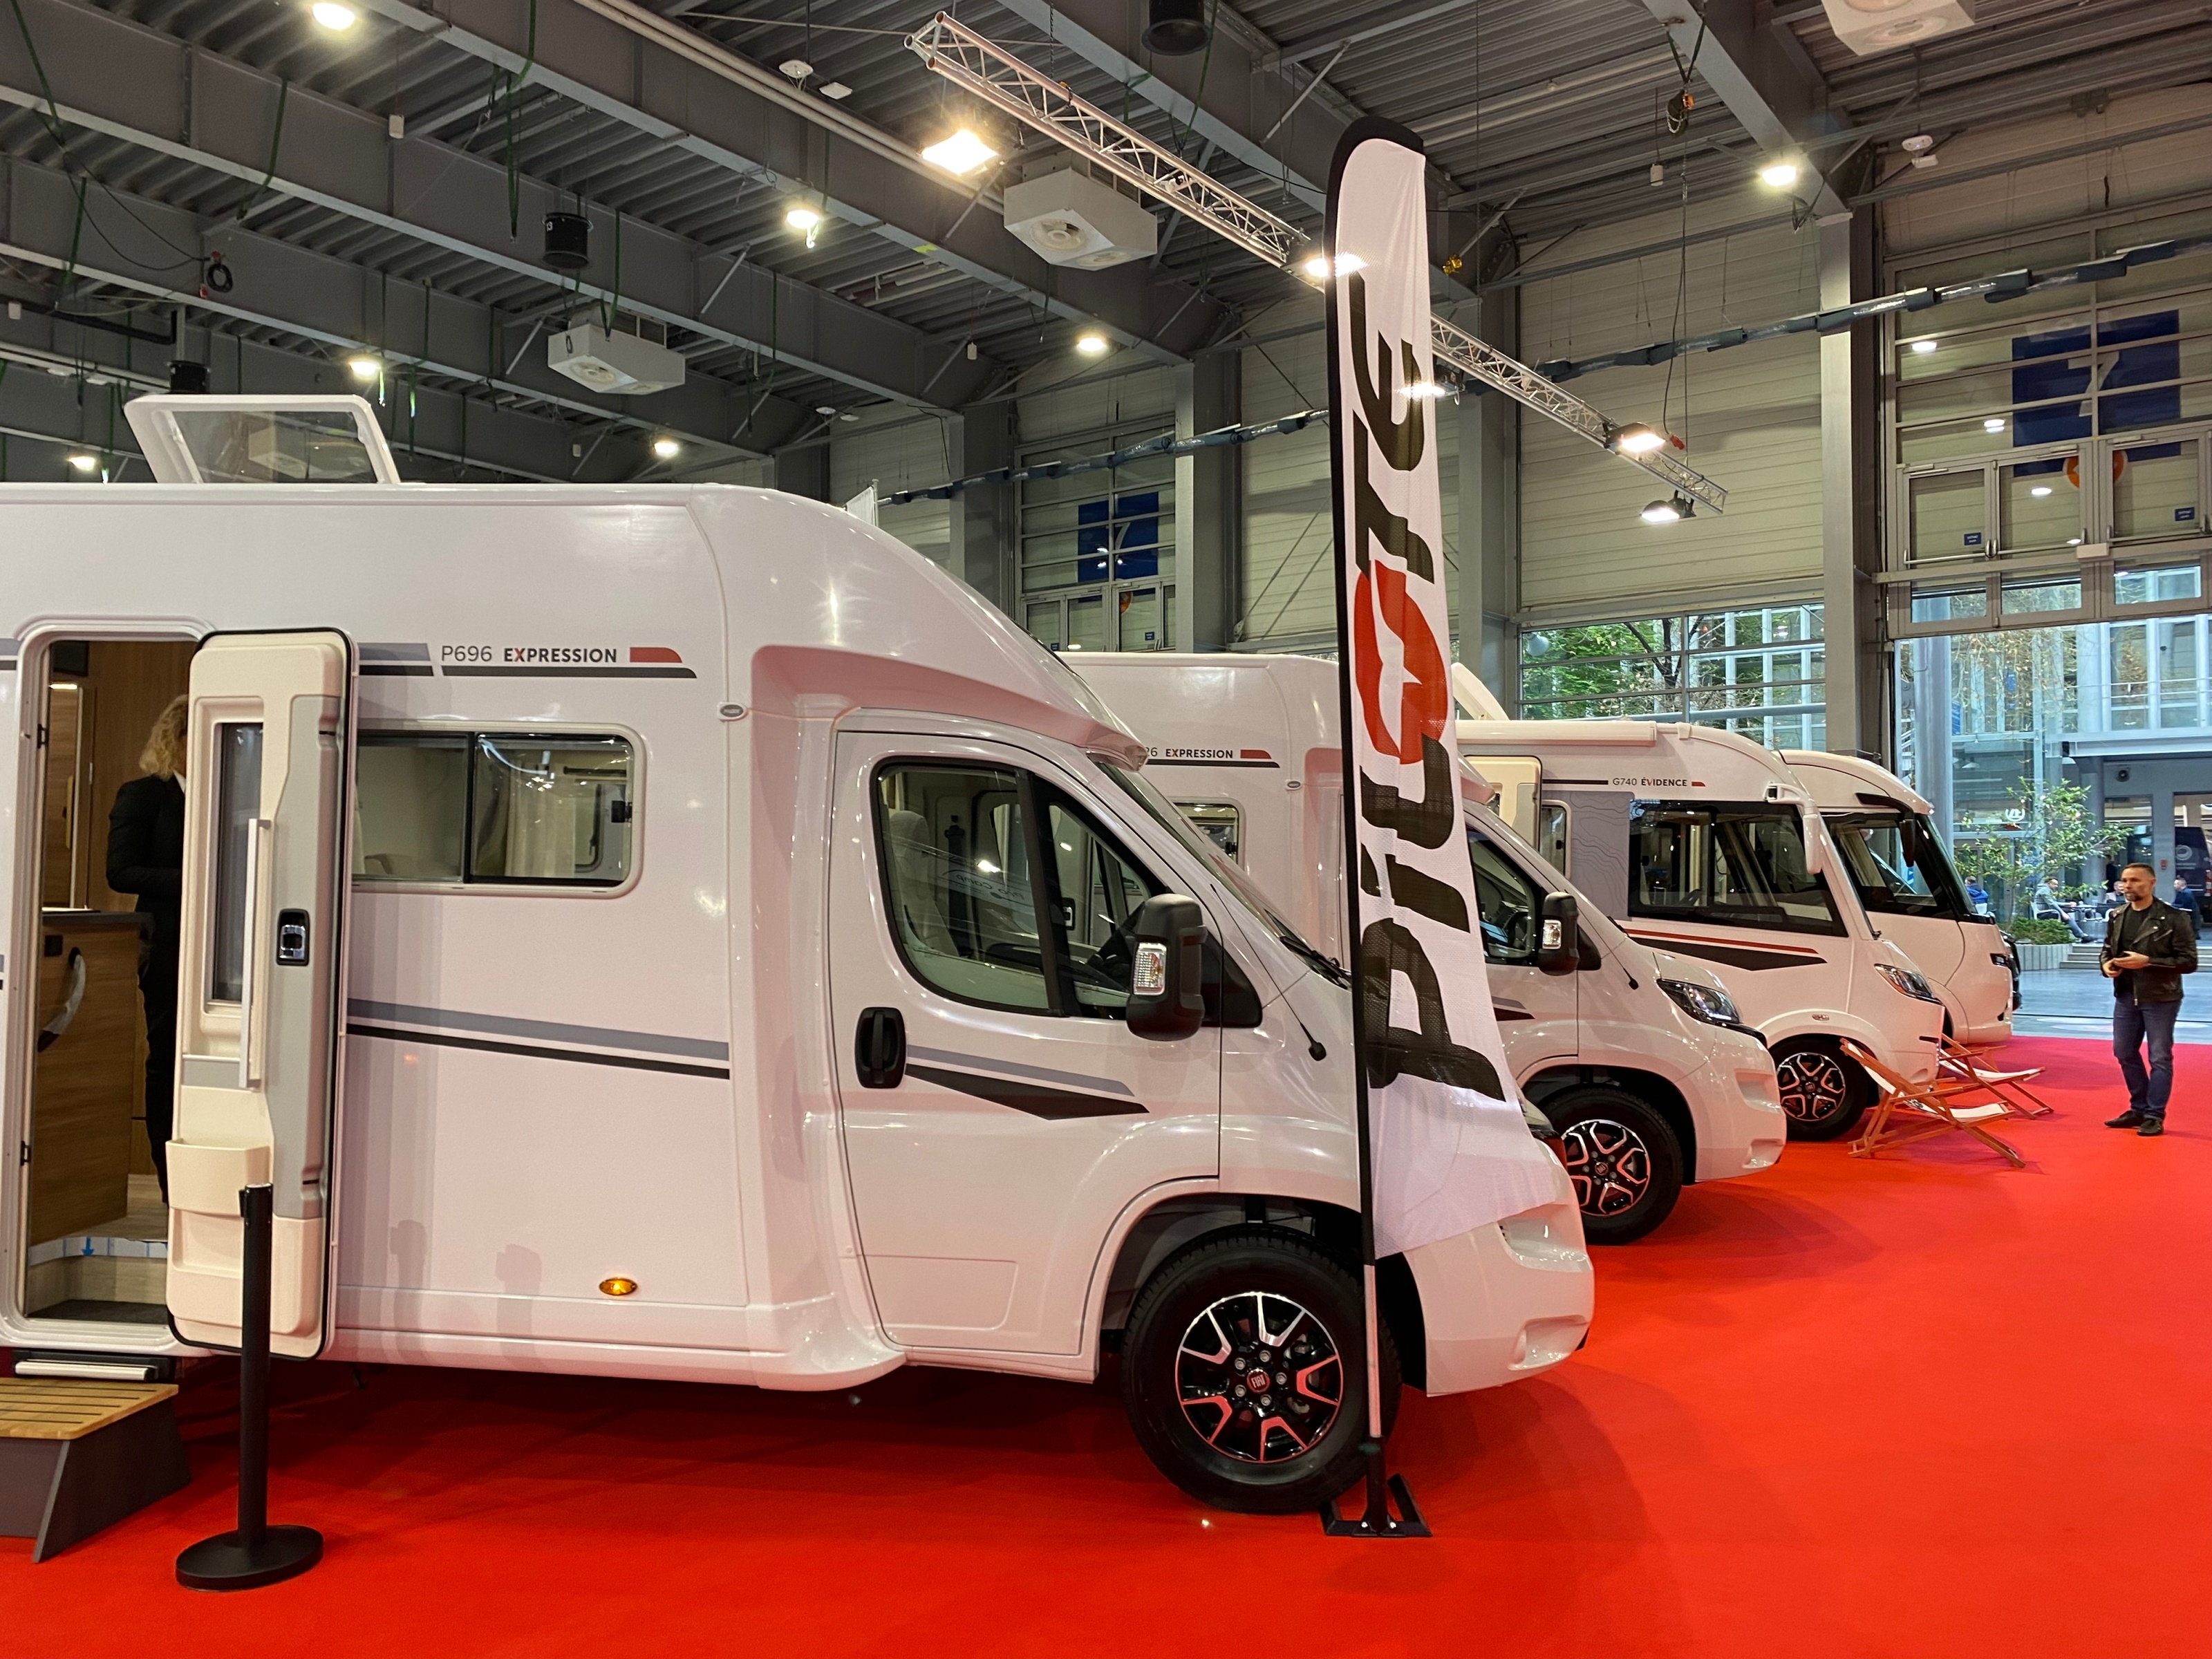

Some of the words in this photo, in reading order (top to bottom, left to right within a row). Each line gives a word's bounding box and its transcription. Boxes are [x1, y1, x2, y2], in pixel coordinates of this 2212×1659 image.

[441, 646, 492, 662] P696
[503, 648, 617, 663] EXPRESSION
[1165, 749, 1233, 759] EXPRESSION
[1613, 778, 1638, 786] G740
[1641, 776, 1687, 787] ÉVIDENCE
[1251, 1375, 1266, 1388] FIAT
